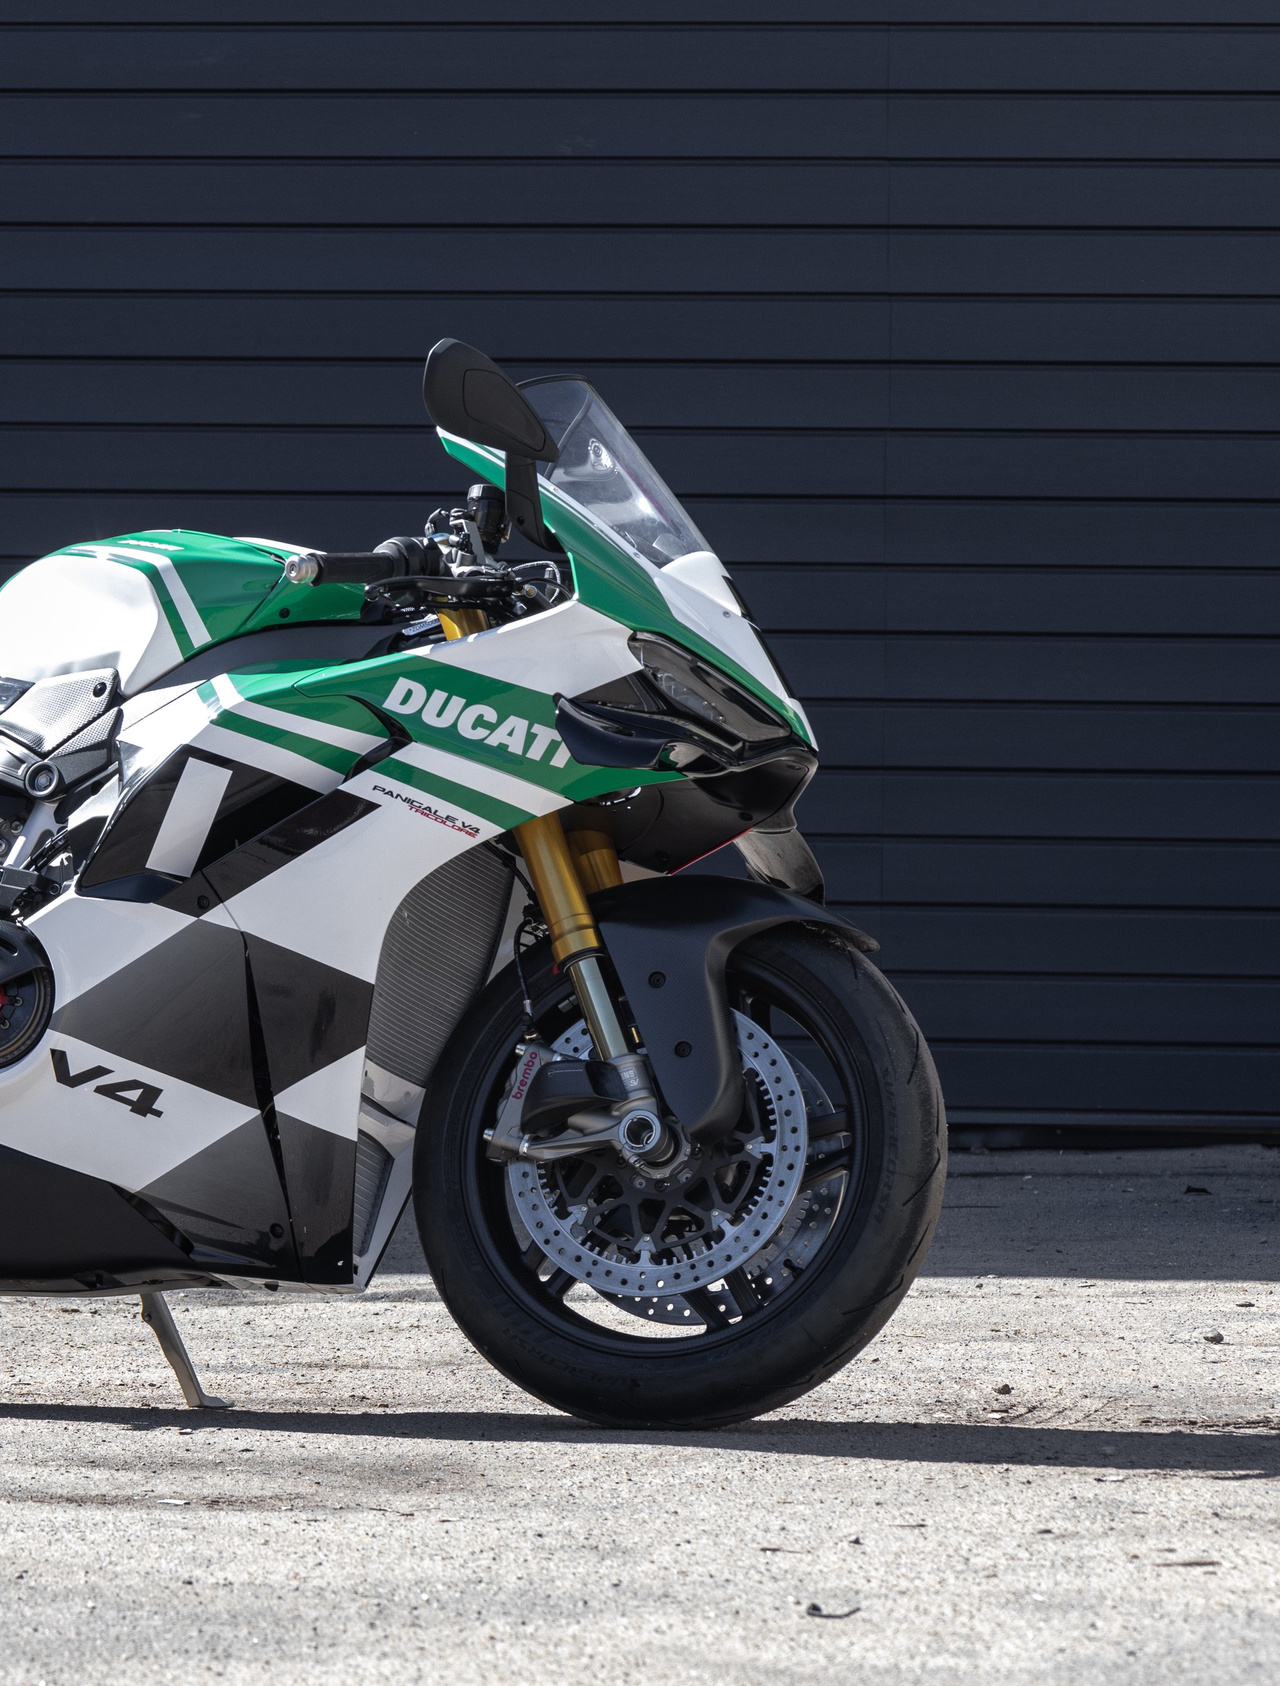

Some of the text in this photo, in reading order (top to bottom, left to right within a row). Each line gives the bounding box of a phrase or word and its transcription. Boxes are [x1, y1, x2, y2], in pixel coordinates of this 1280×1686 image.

[382, 676, 571, 769] DUCATI
[372, 785, 481, 835] PANIGALE V4
[408, 804, 479, 839] TRICOLORE
[50, 1048, 164, 1119] V4
[512, 1051, 538, 1100] brembo
